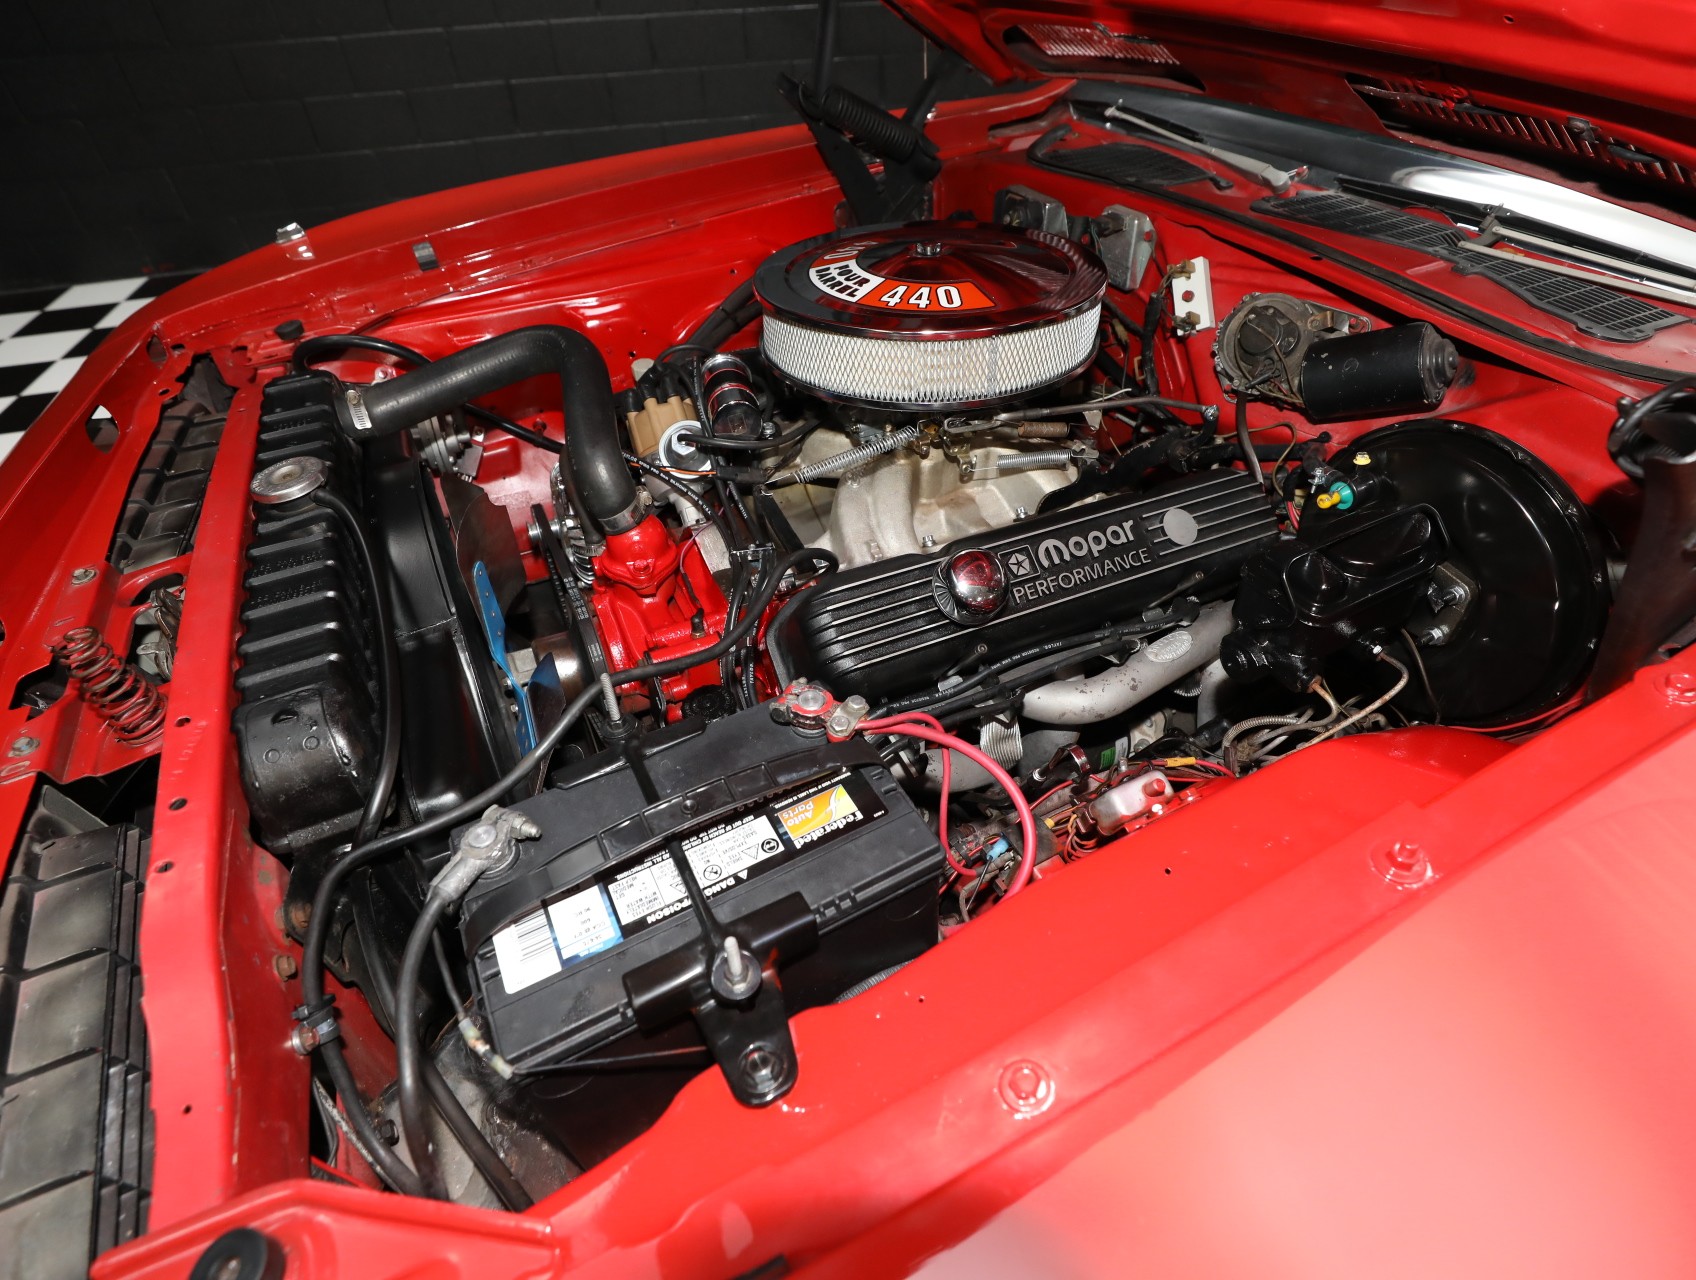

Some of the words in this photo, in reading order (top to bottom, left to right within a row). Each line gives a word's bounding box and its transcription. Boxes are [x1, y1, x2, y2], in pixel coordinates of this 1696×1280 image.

[815, 266, 860, 298] BARREL
[834, 264, 871, 288] FOUR
[880, 285, 963, 309] 440
[687, 490, 698, 501] MADE
[1012, 548, 1152, 604] PERFORMANCE
[796, 789, 808, 798] LABEL
[742, 814, 754, 823] KEEP
[781, 799, 813, 820] Parts
[785, 808, 814, 828] Auto
[708, 828, 725, 838] REACH
[731, 820, 742, 828] OUT
[793, 809, 863, 850] Federated
[652, 856, 662, 864] ALL
[614, 860, 652, 880] INSTRUCTIONS.
[625, 897, 643, 907] WATER
[625, 895, 659, 913] IMMEDIATELY
[643, 891, 657, 899] WITH
